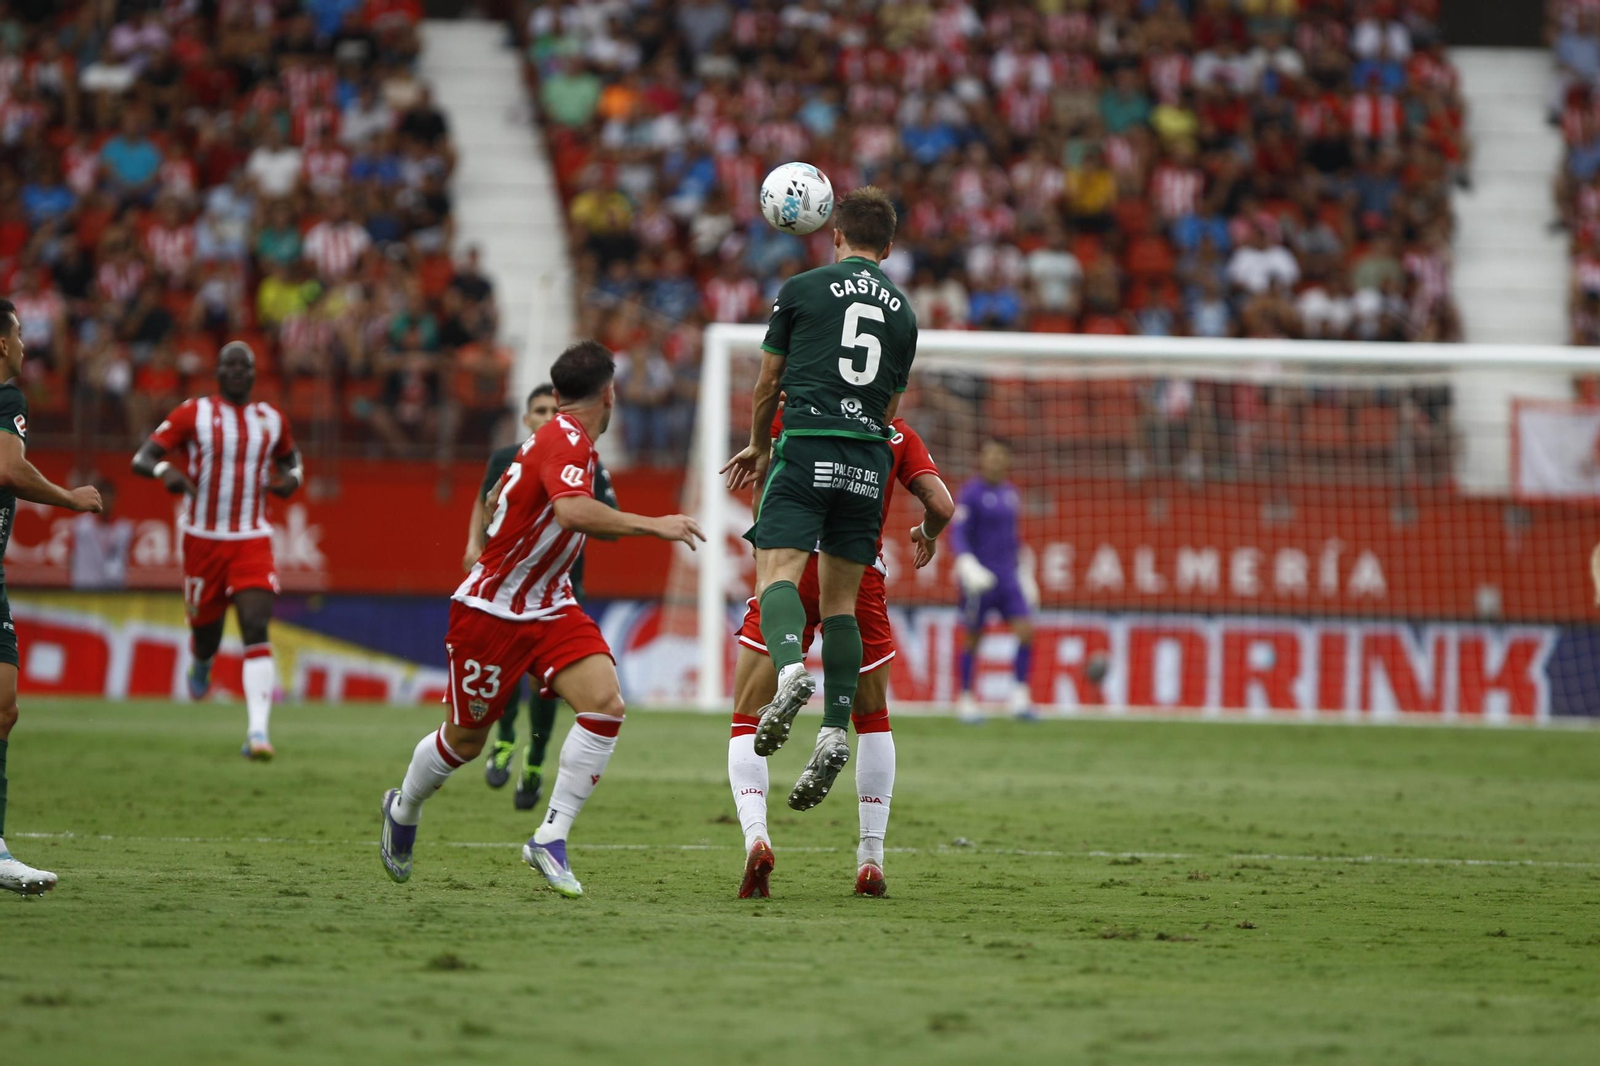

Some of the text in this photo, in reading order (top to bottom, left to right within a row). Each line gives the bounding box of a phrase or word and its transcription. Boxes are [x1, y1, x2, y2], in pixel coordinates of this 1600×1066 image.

[829, 278, 901, 311] CASTRO
[838, 302, 885, 386] 5
[834, 463, 879, 485] PALETS DEL
[1086, 537, 1388, 597] ALMERÍA
[461, 659, 502, 699] 23
[740, 787, 764, 797] UDA
